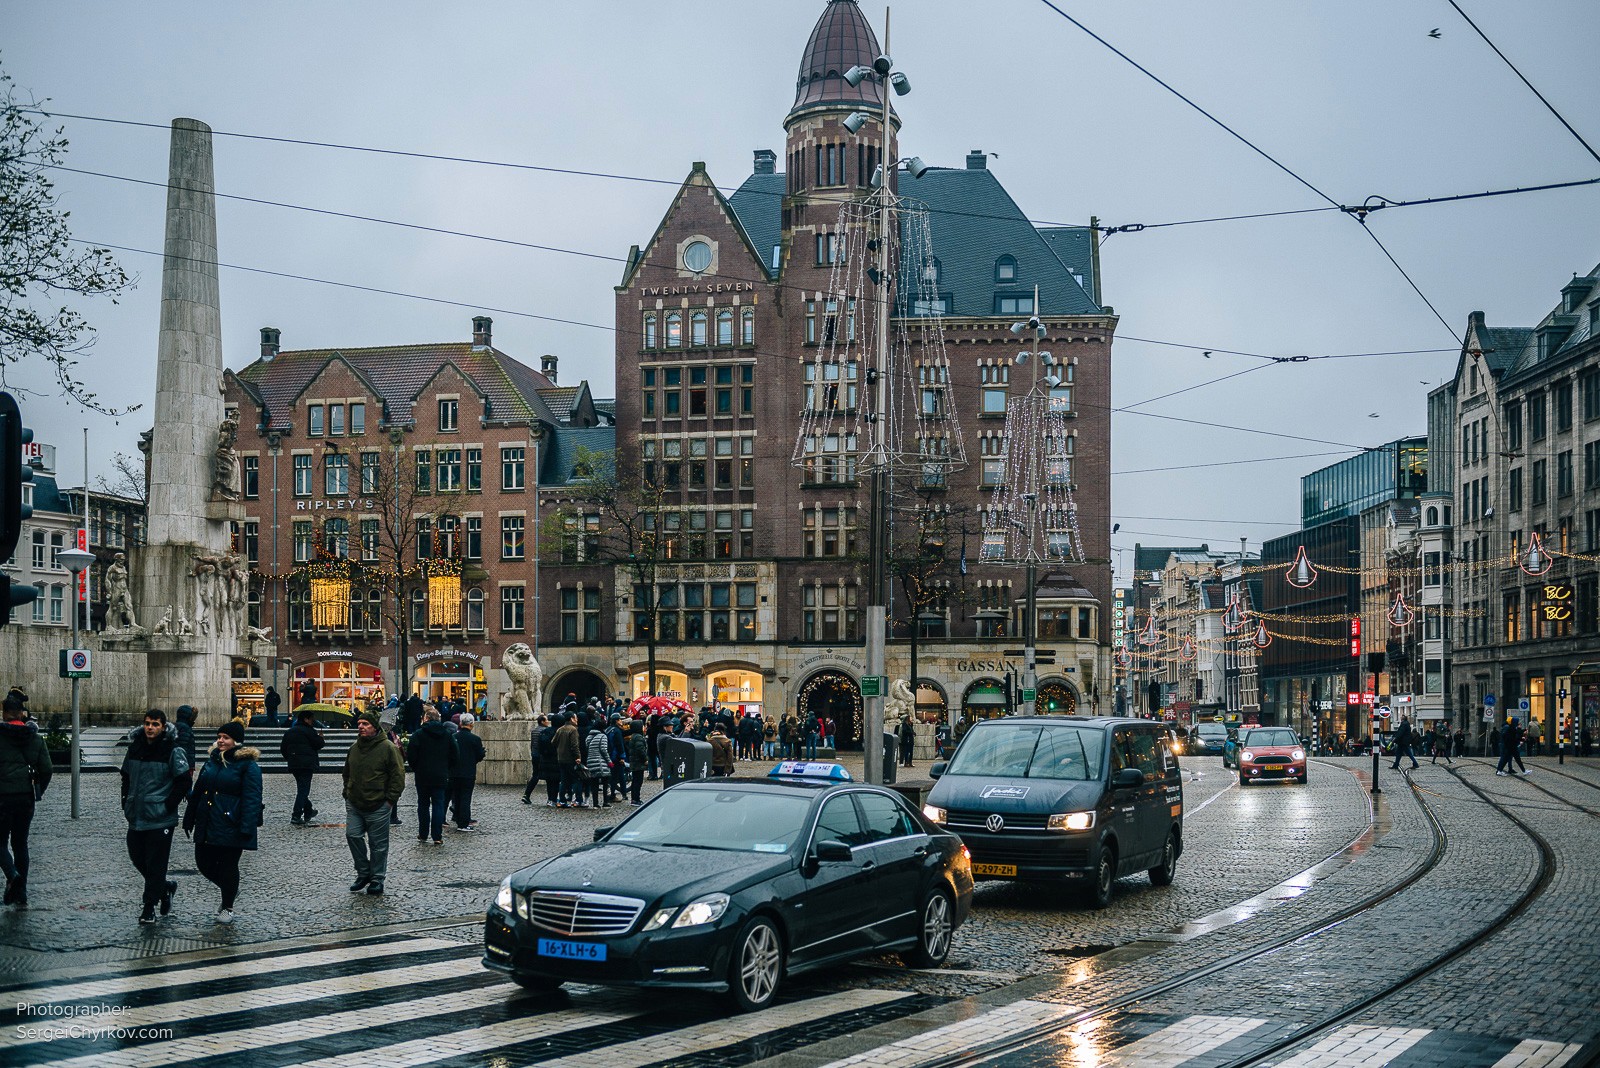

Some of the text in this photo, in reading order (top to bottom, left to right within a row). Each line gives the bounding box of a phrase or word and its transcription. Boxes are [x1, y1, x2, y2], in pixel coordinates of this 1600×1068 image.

[641, 282, 753, 296] TWENTY SEVEN
[296, 500, 374, 510] RIPLEY'S
[957, 660, 1016, 672] GASSAN
[974, 865, 1013, 875] V-297-ZH
[545, 941, 597, 957] 16-XLH-6
